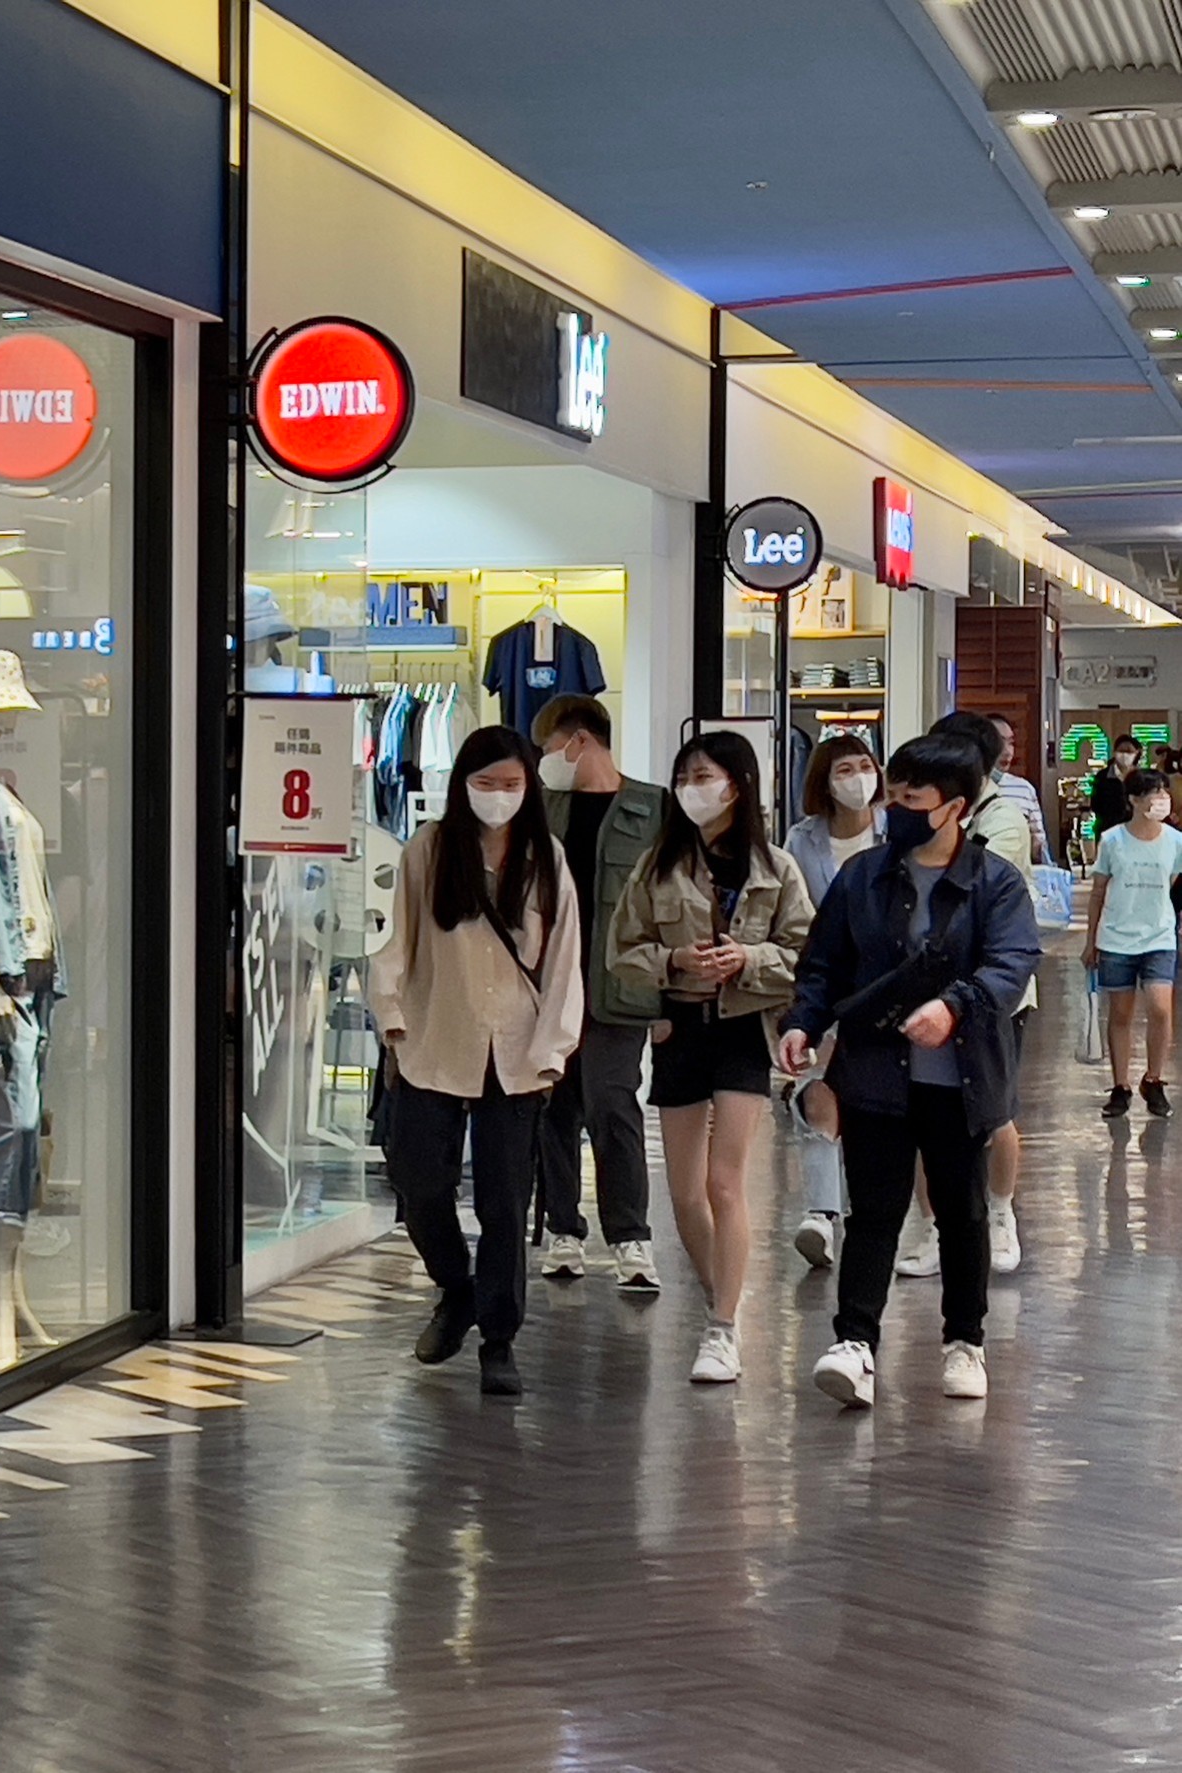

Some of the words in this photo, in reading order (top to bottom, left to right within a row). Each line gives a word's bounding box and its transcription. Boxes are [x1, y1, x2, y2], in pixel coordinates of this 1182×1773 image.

[558, 311, 606, 436] Lee
[280, 380, 378, 419] EDWIN
[743, 527, 804, 564] Lee
[366, 582, 448, 628] MEN
[282, 768, 311, 820] 8
